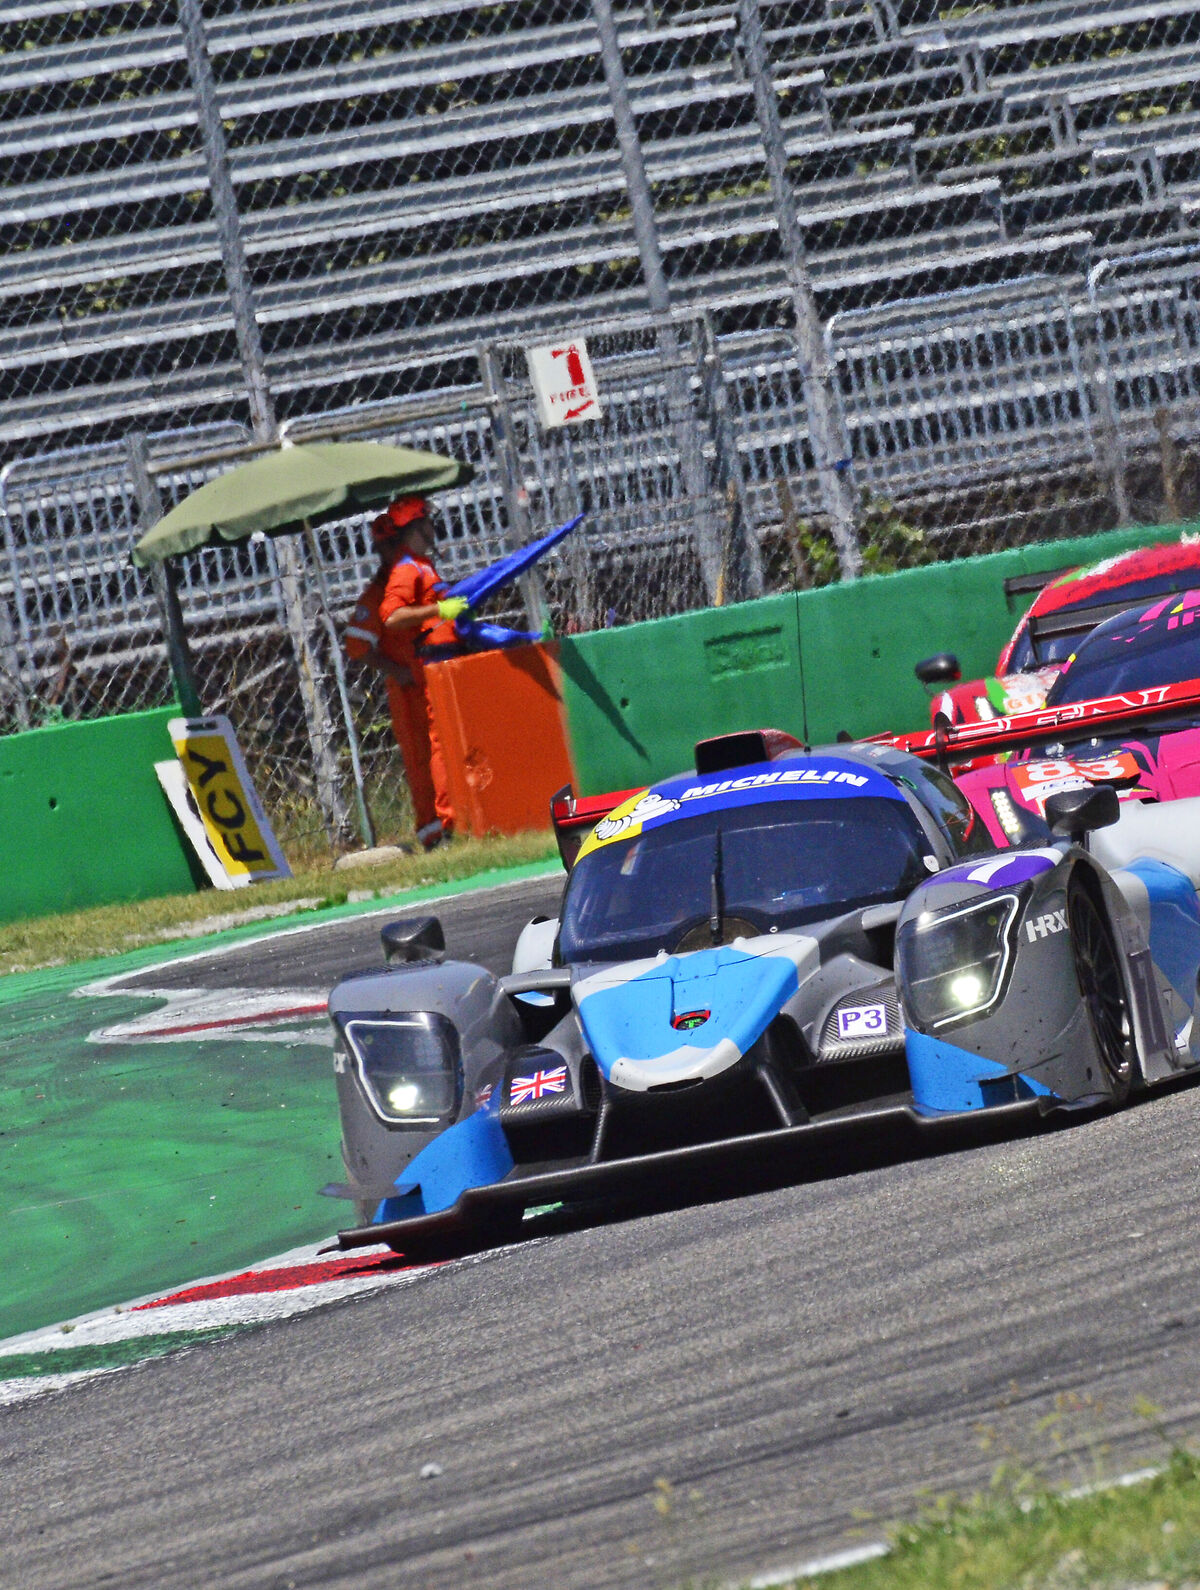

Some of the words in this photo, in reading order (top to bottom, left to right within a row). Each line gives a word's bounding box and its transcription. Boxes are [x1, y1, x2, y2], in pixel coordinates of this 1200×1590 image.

[1026, 759, 1125, 781] 83
[680, 770, 869, 799] MICHELIN
[187, 749, 265, 863] FCY
[842, 1009, 882, 1031] P3
